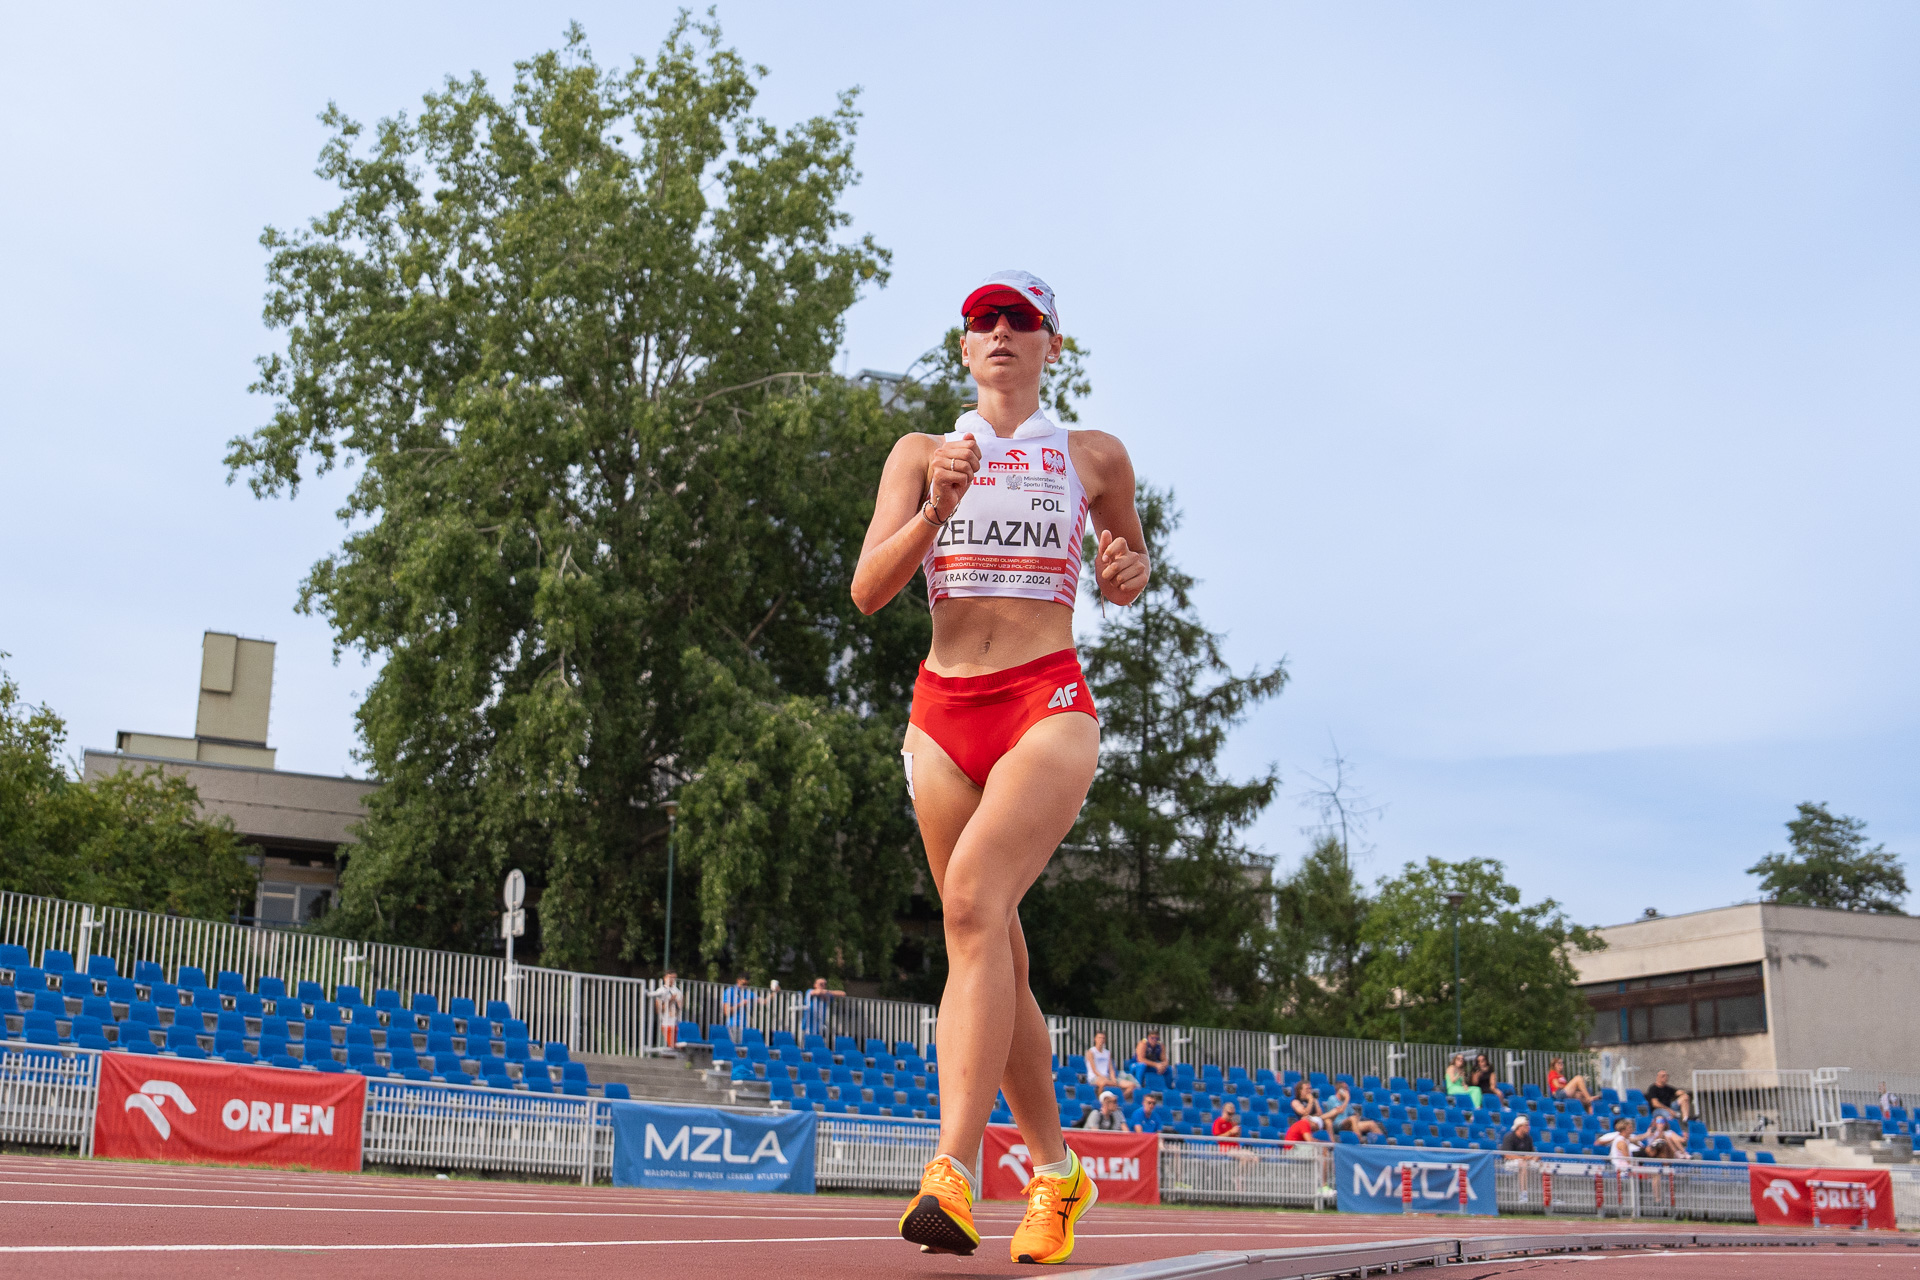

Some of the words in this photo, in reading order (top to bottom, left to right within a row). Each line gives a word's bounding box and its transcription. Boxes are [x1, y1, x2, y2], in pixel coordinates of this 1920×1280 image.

[990, 463, 1027, 471] ORLEN
[972, 477, 996, 487] LEN
[1031, 498, 1065, 513] POL
[944, 570, 989, 583] KRAKÓW
[992, 574, 1051, 585] 20.07.2024
[1047, 682, 1078, 709] 4F
[221, 1098, 335, 1136] ORLEN
[644, 1122, 789, 1165] MZLA
[1081, 1156, 1140, 1181] RLEN
[1815, 1188, 1876, 1210] ORLEN
